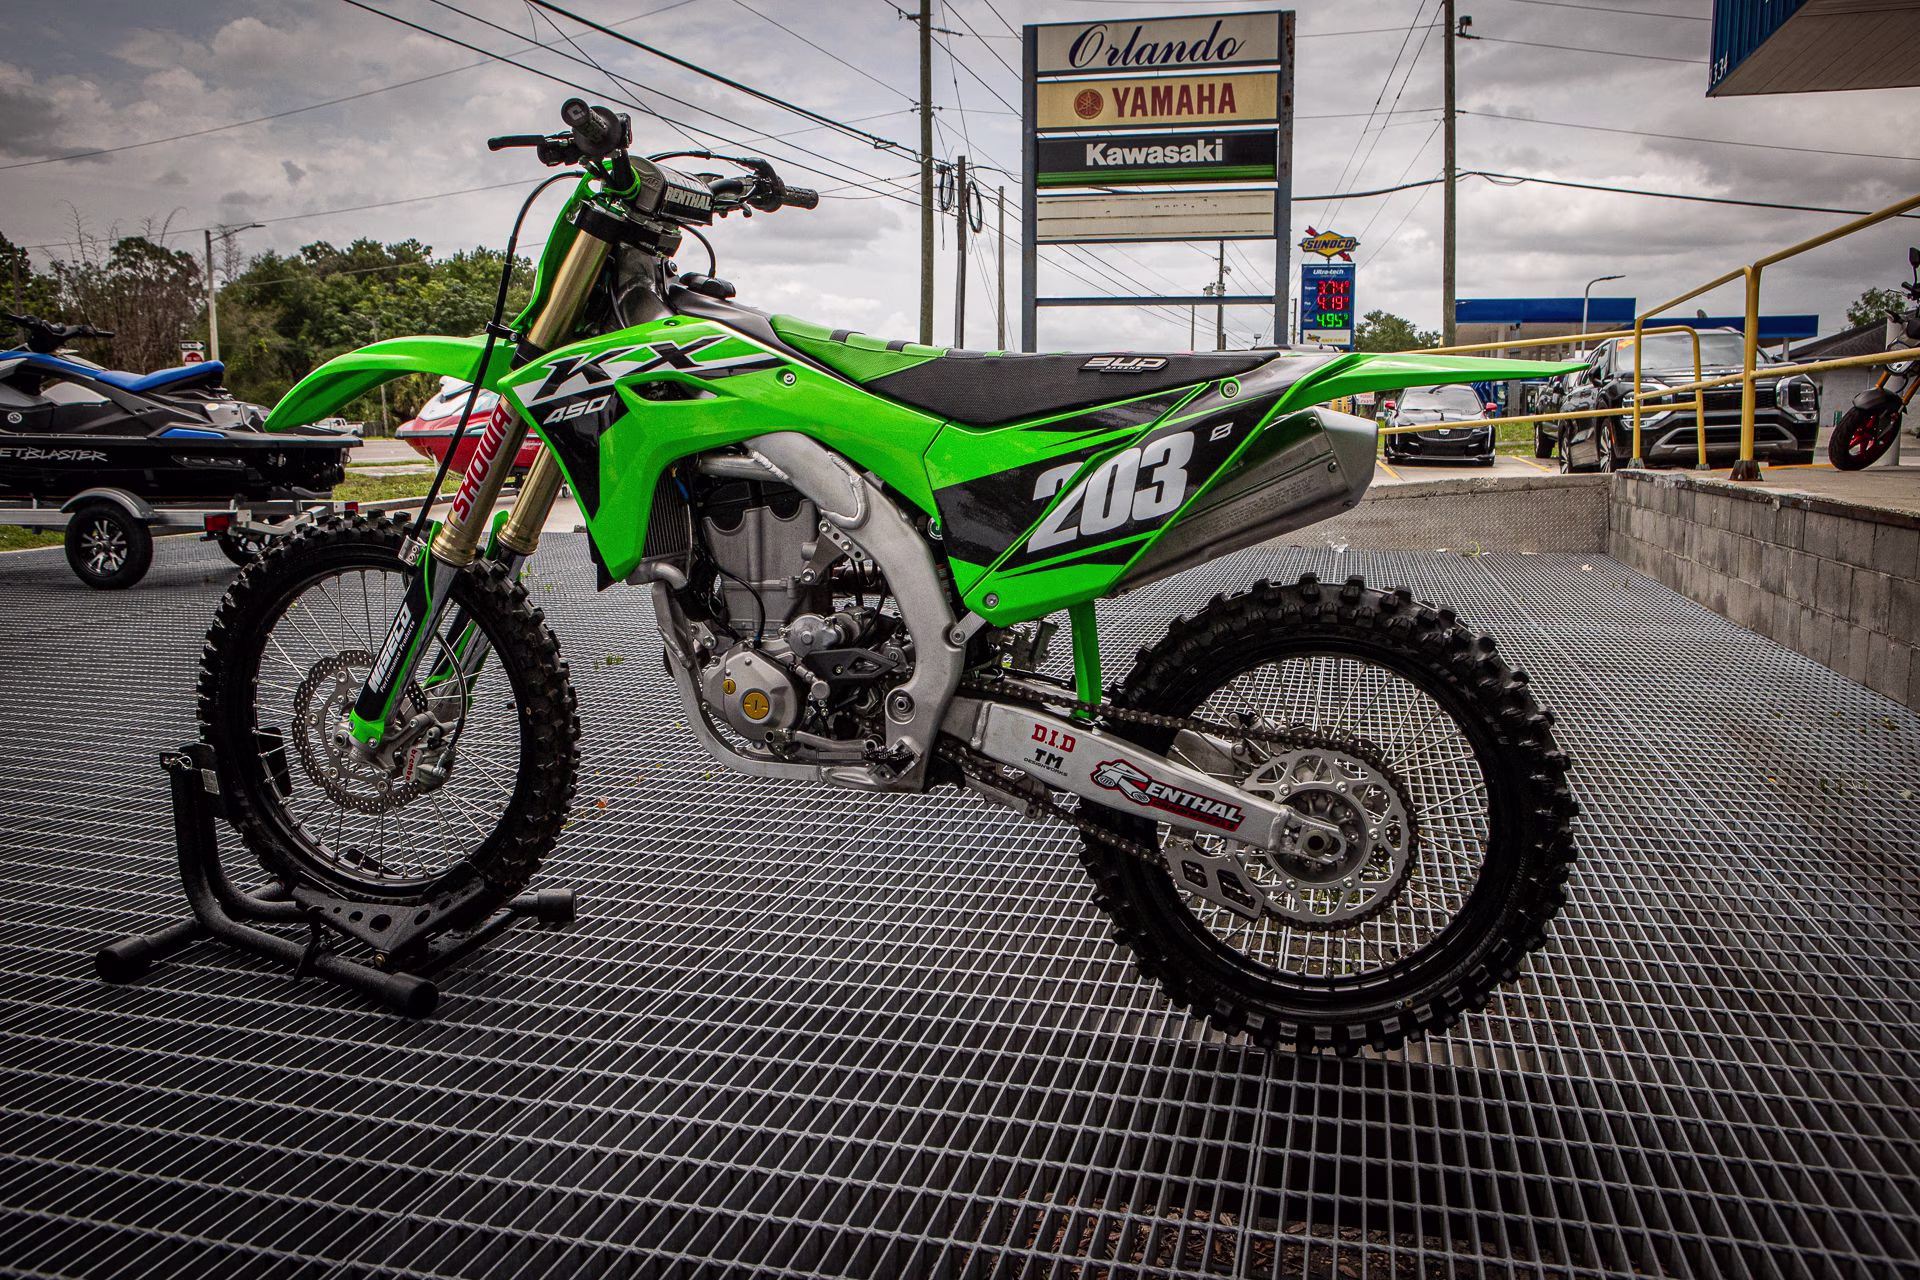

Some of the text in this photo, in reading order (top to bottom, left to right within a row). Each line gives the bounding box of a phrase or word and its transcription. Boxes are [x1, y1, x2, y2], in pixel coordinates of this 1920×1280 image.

[1068, 19, 1247, 69] Orlando
[1111, 82, 1237, 118] YAMAHA
[1085, 138, 1223, 166] Kawasaki
[665, 185, 713, 211] RENTHAL
[1307, 239, 1353, 249] SUNOCO
[532, 334, 733, 401] KX
[1084, 357, 1167, 367] BUD
[542, 394, 612, 425] 450
[453, 402, 513, 524] SHOWA
[1026, 430, 1196, 554] 203
[1031, 723, 1077, 753] D.I.D
[1023, 757, 1068, 777] DESIGNWORKS
[1034, 747, 1065, 770] TM
